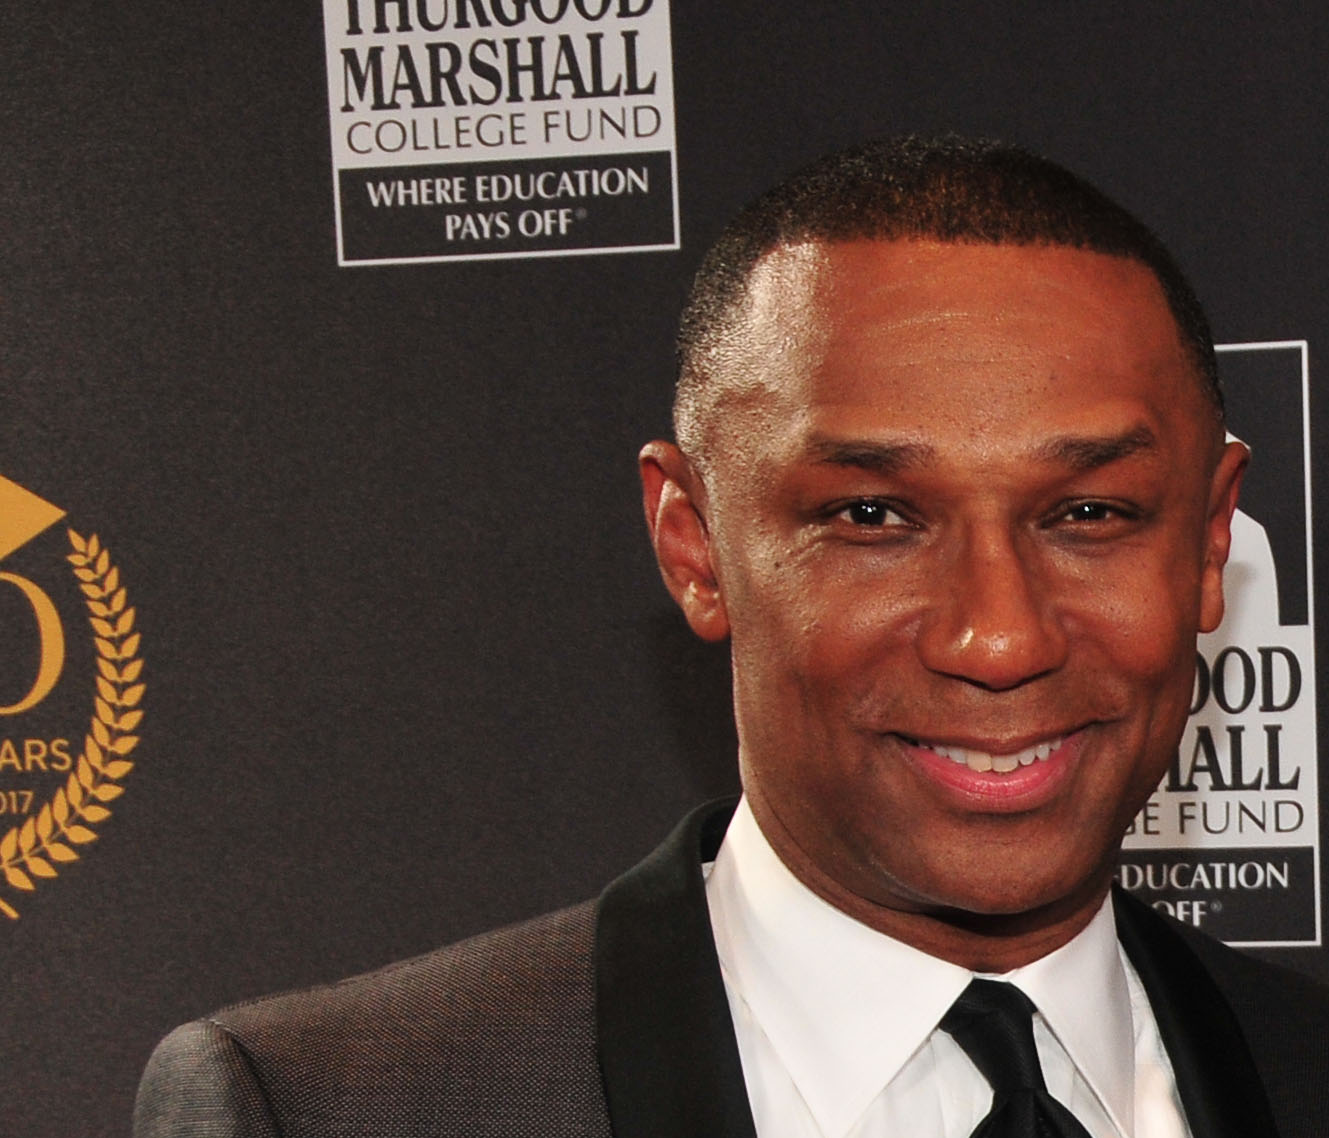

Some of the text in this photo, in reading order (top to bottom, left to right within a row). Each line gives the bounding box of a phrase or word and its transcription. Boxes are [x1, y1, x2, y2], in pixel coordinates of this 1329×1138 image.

[340, 30, 658, 112] MARSHALL
[347, 104, 662, 154] COLLEGE FUND
[366, 166, 650, 208] WHERE EDUCATION
[444, 211, 510, 242] PAYS
[1178, 800, 1305, 834] FUND
[1113, 861, 1290, 890] DUCATION
